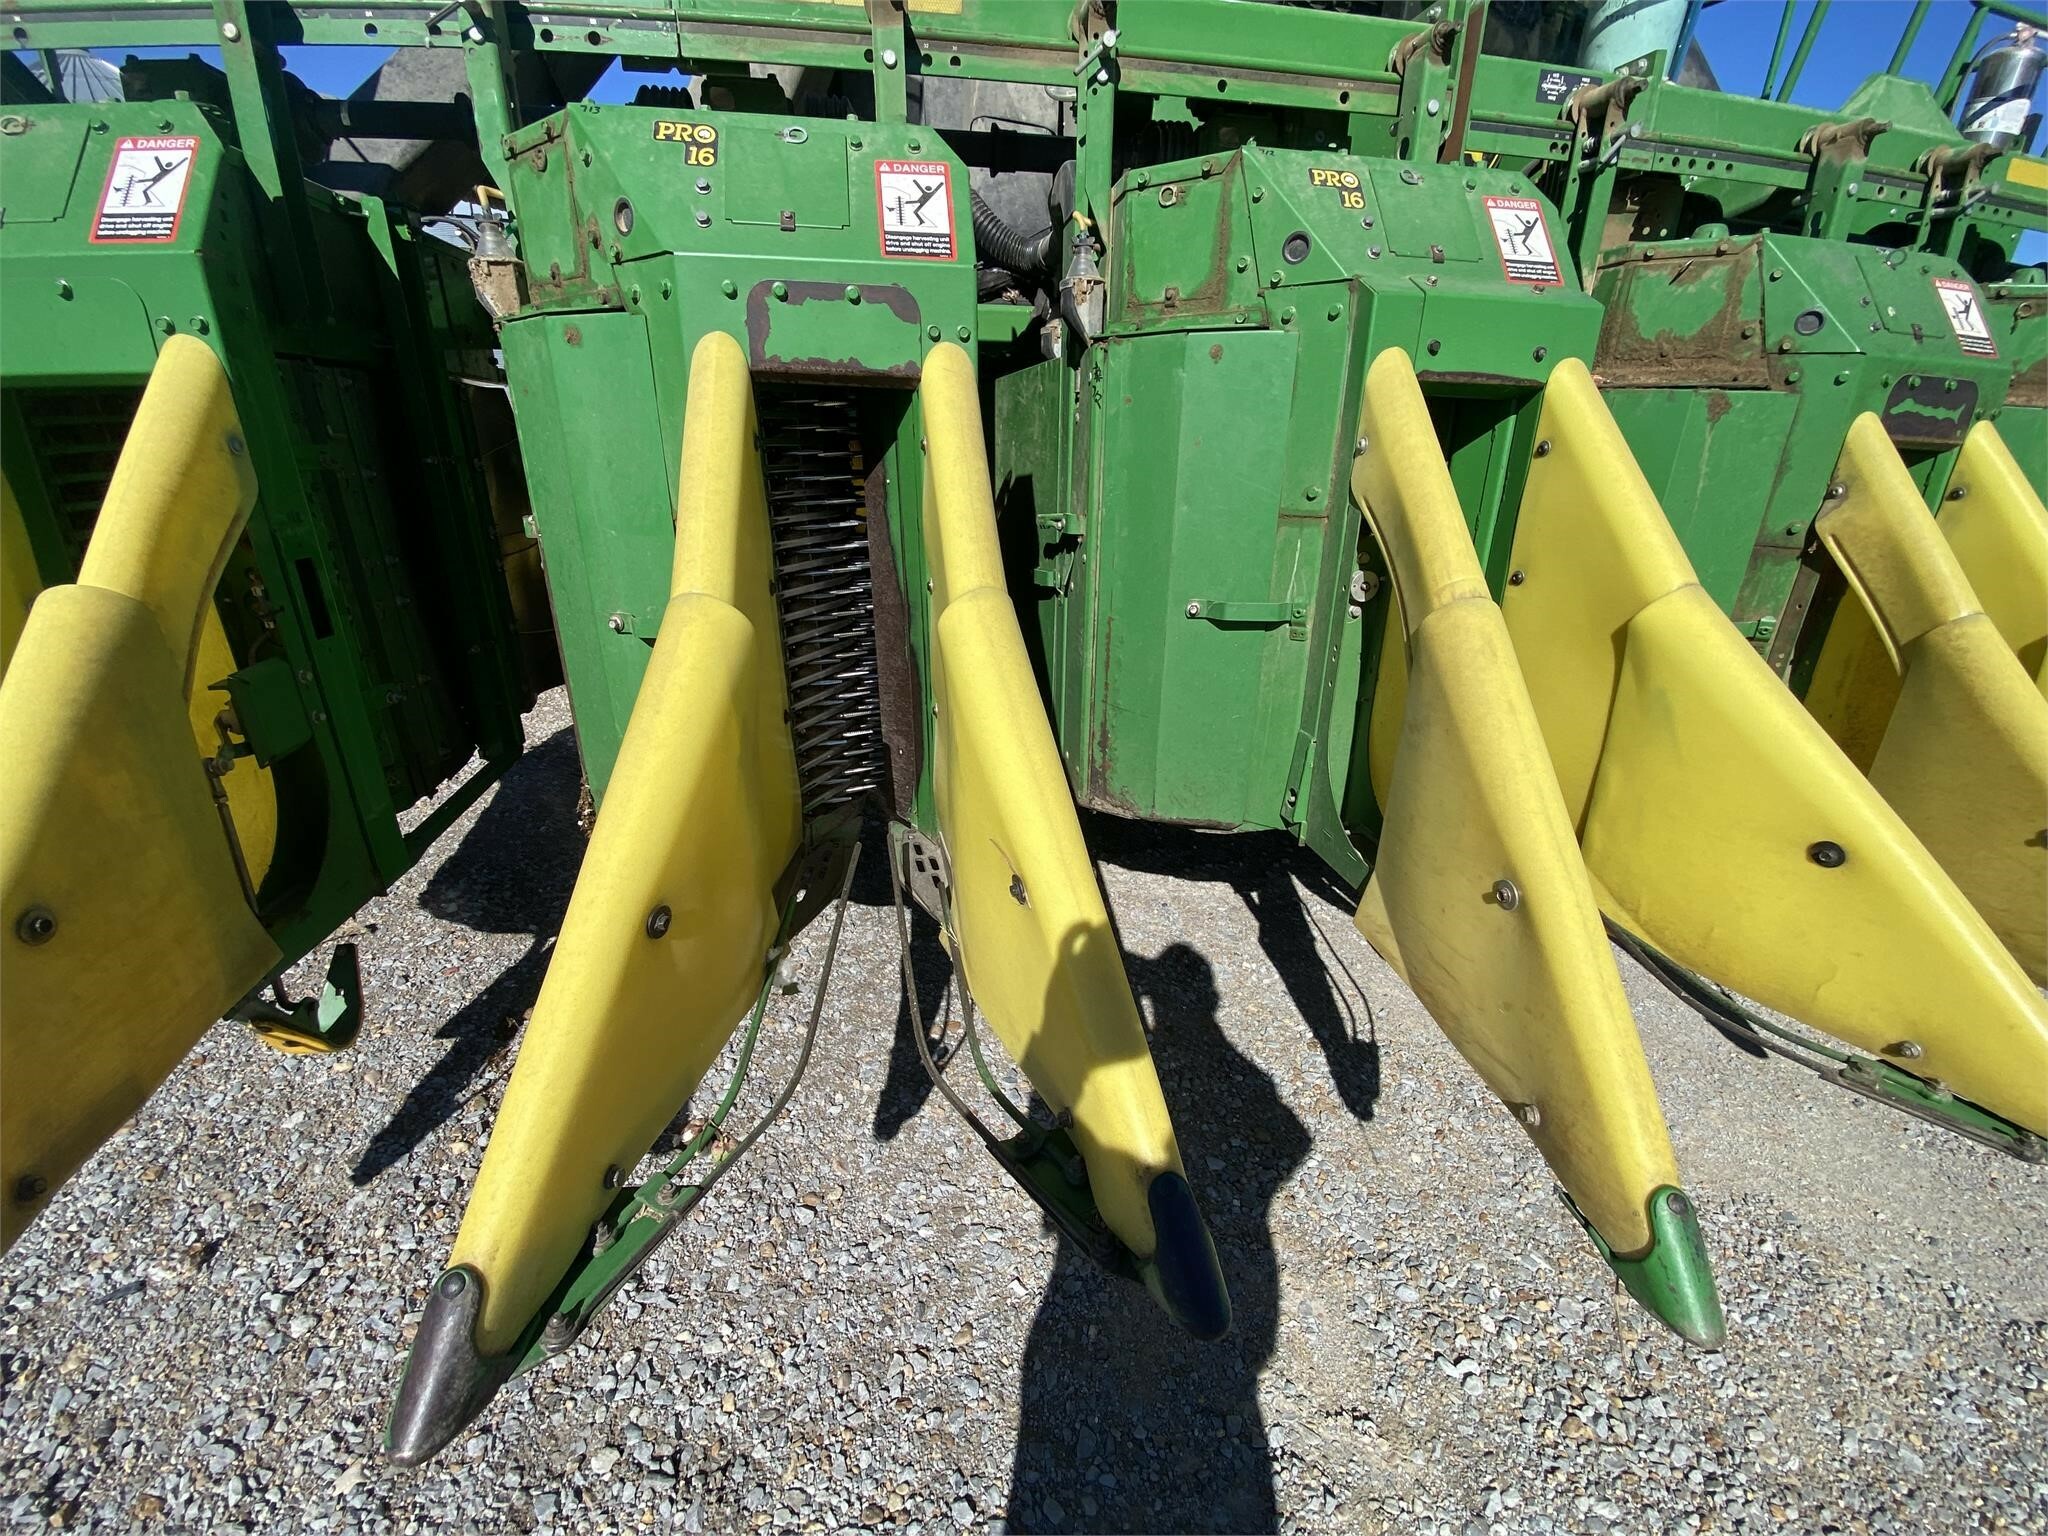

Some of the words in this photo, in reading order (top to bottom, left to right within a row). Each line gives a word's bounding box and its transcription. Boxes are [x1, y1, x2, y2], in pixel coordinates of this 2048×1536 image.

[656, 122, 716, 144] PRO
[136, 139, 196, 148] DANGER
[688, 146, 714, 166] 16
[893, 164, 944, 174] DANGER
[1312, 170, 1359, 188] PRO
[1342, 190, 1364, 208] 16
[1496, 200, 1538, 210] DANGER
